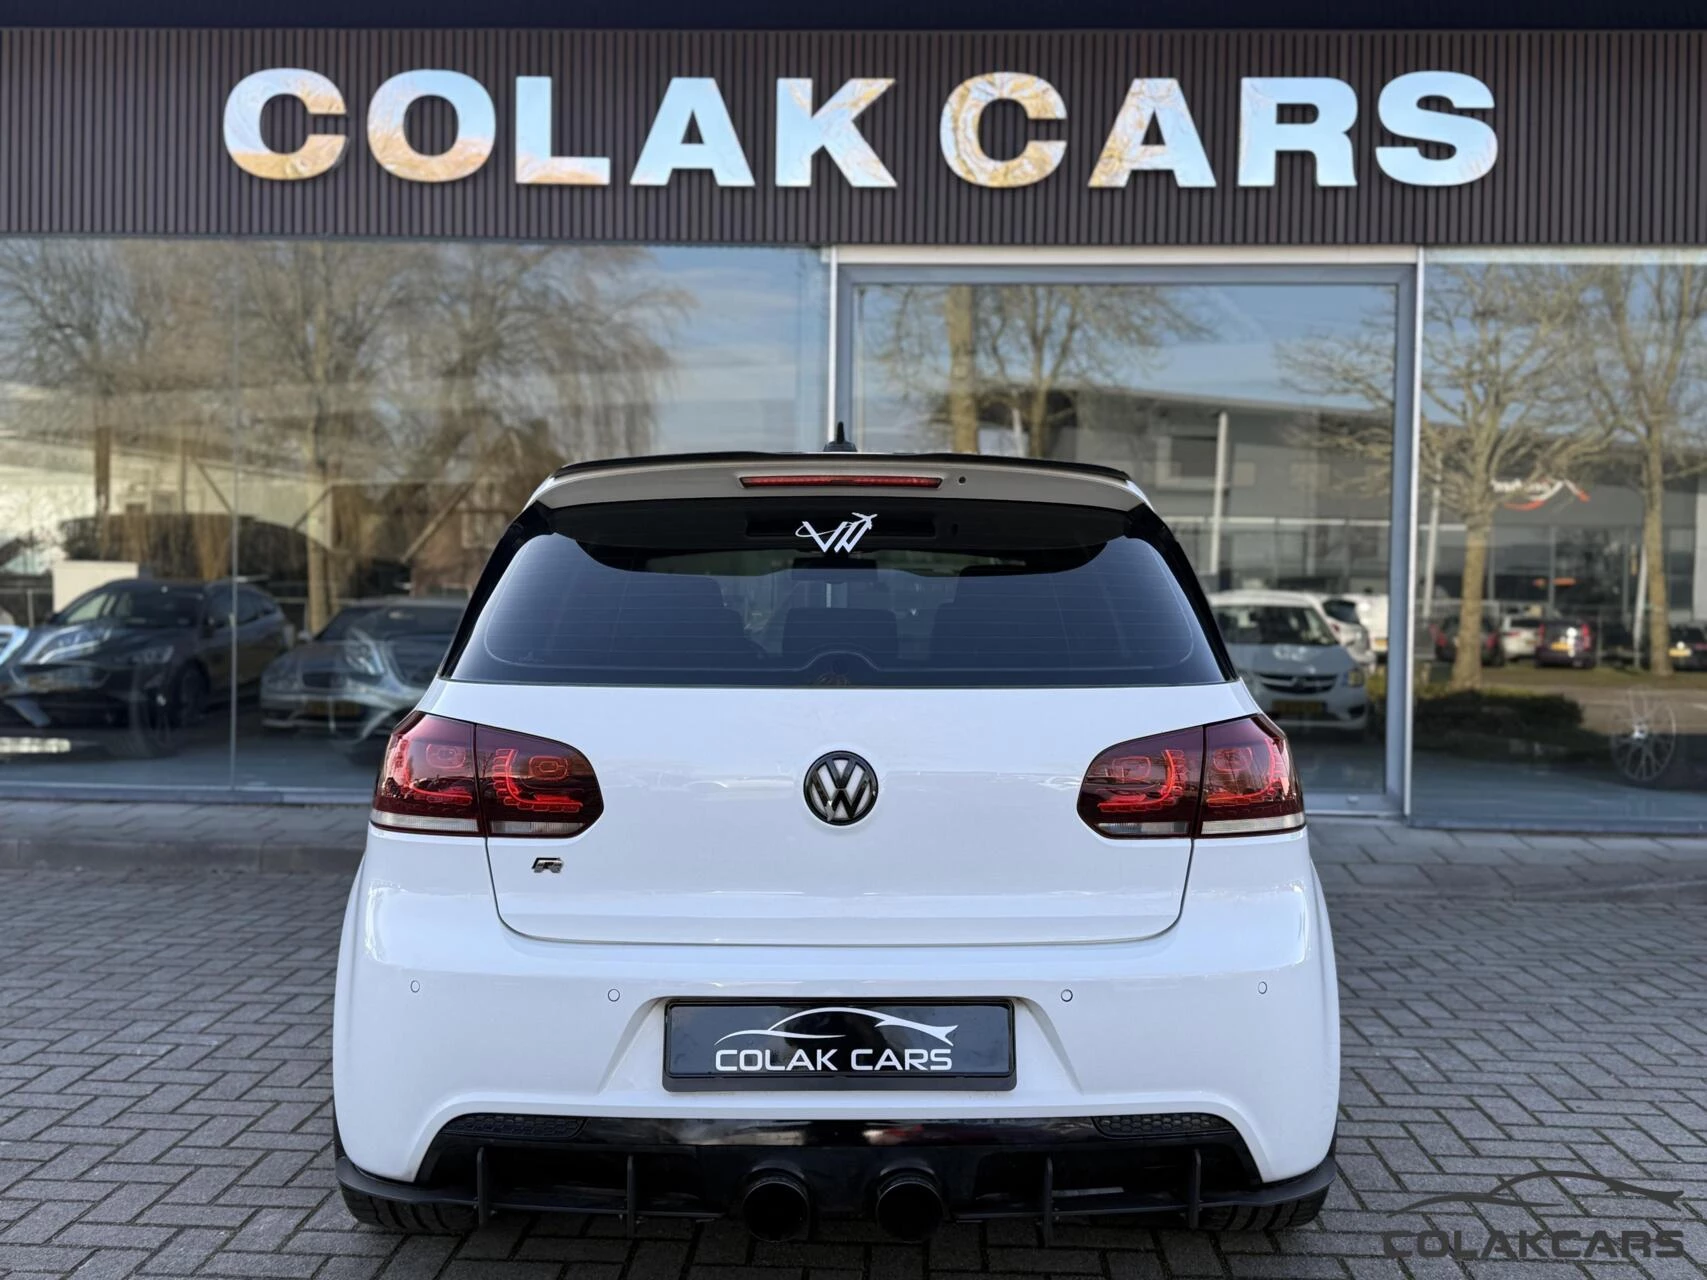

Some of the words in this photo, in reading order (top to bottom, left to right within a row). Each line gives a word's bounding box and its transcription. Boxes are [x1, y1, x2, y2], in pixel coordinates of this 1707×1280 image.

[223, 68, 898, 188] COLAK
[939, 70, 1499, 188] CARS
[805, 752, 876, 824] VW
[532, 857, 563, 873] R
[715, 1048, 839, 1072] COLAK
[850, 1048, 953, 1072] CARS
